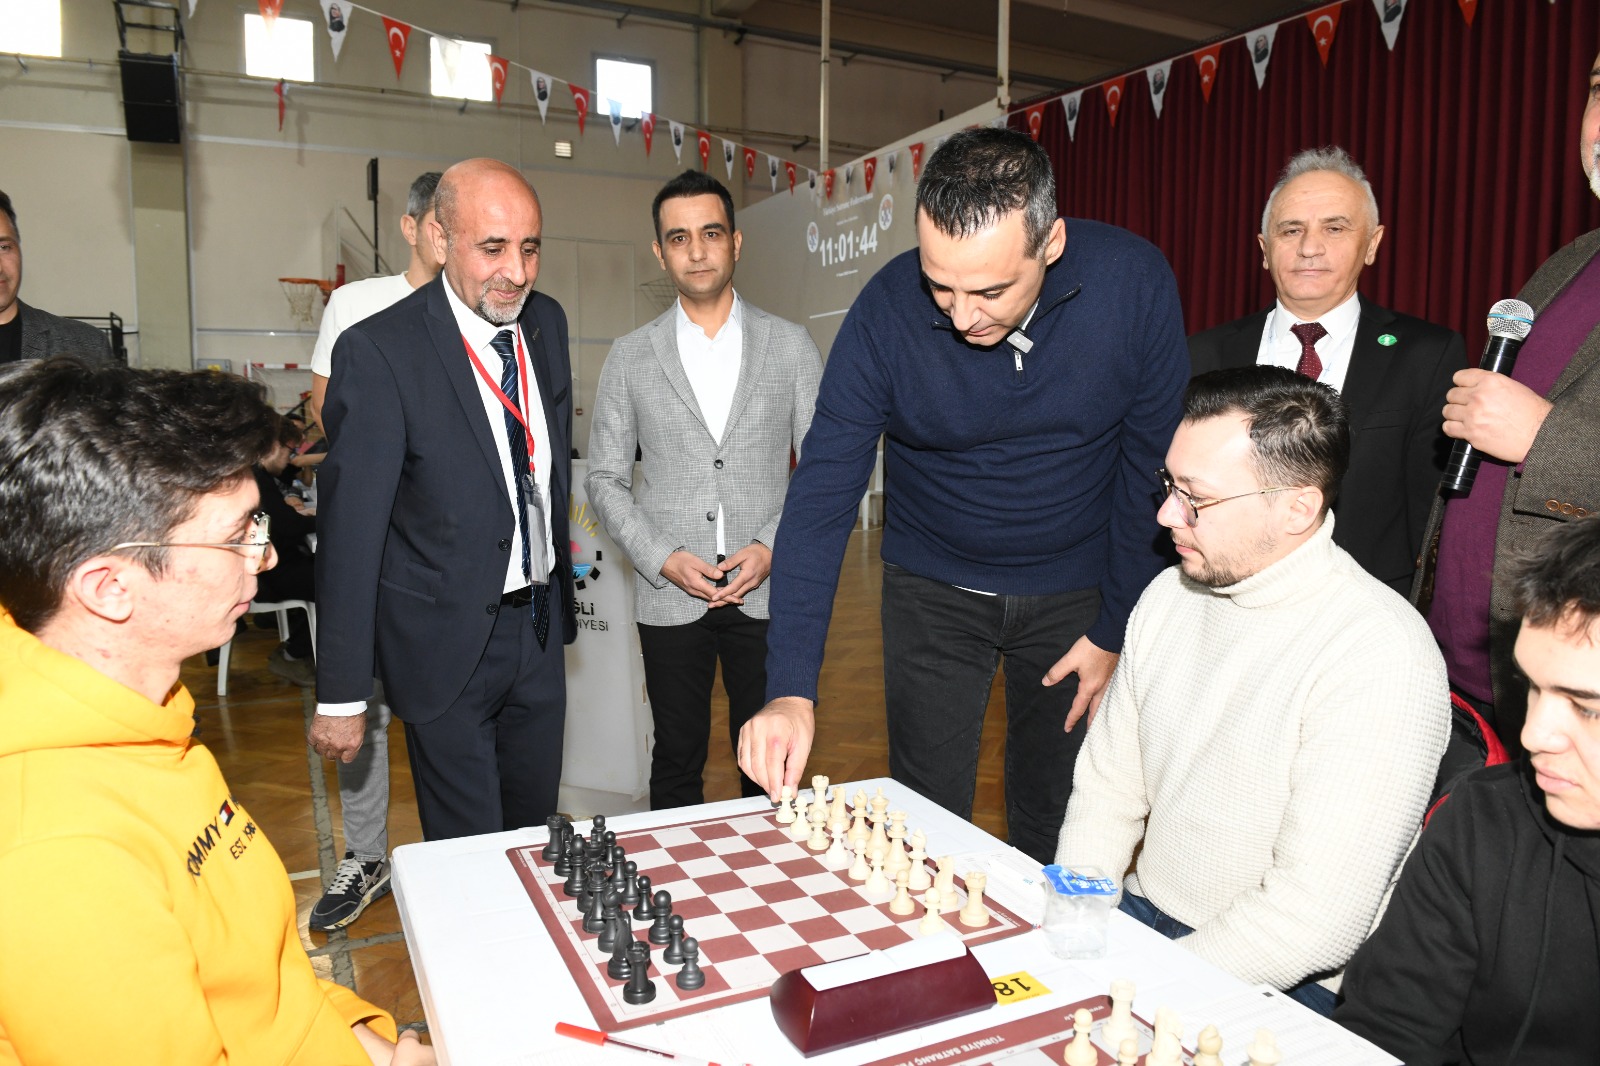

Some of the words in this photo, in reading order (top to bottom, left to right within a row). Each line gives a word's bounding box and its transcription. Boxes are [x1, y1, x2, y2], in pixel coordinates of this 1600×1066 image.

[819, 222, 878, 267] 11:01:44
[187, 816, 222, 877] OMMY
[991, 977, 1031, 996] 18
[960, 1035, 1006, 1053] TÜRKİYE
[913, 1046, 962, 1066] SATRANÇ
